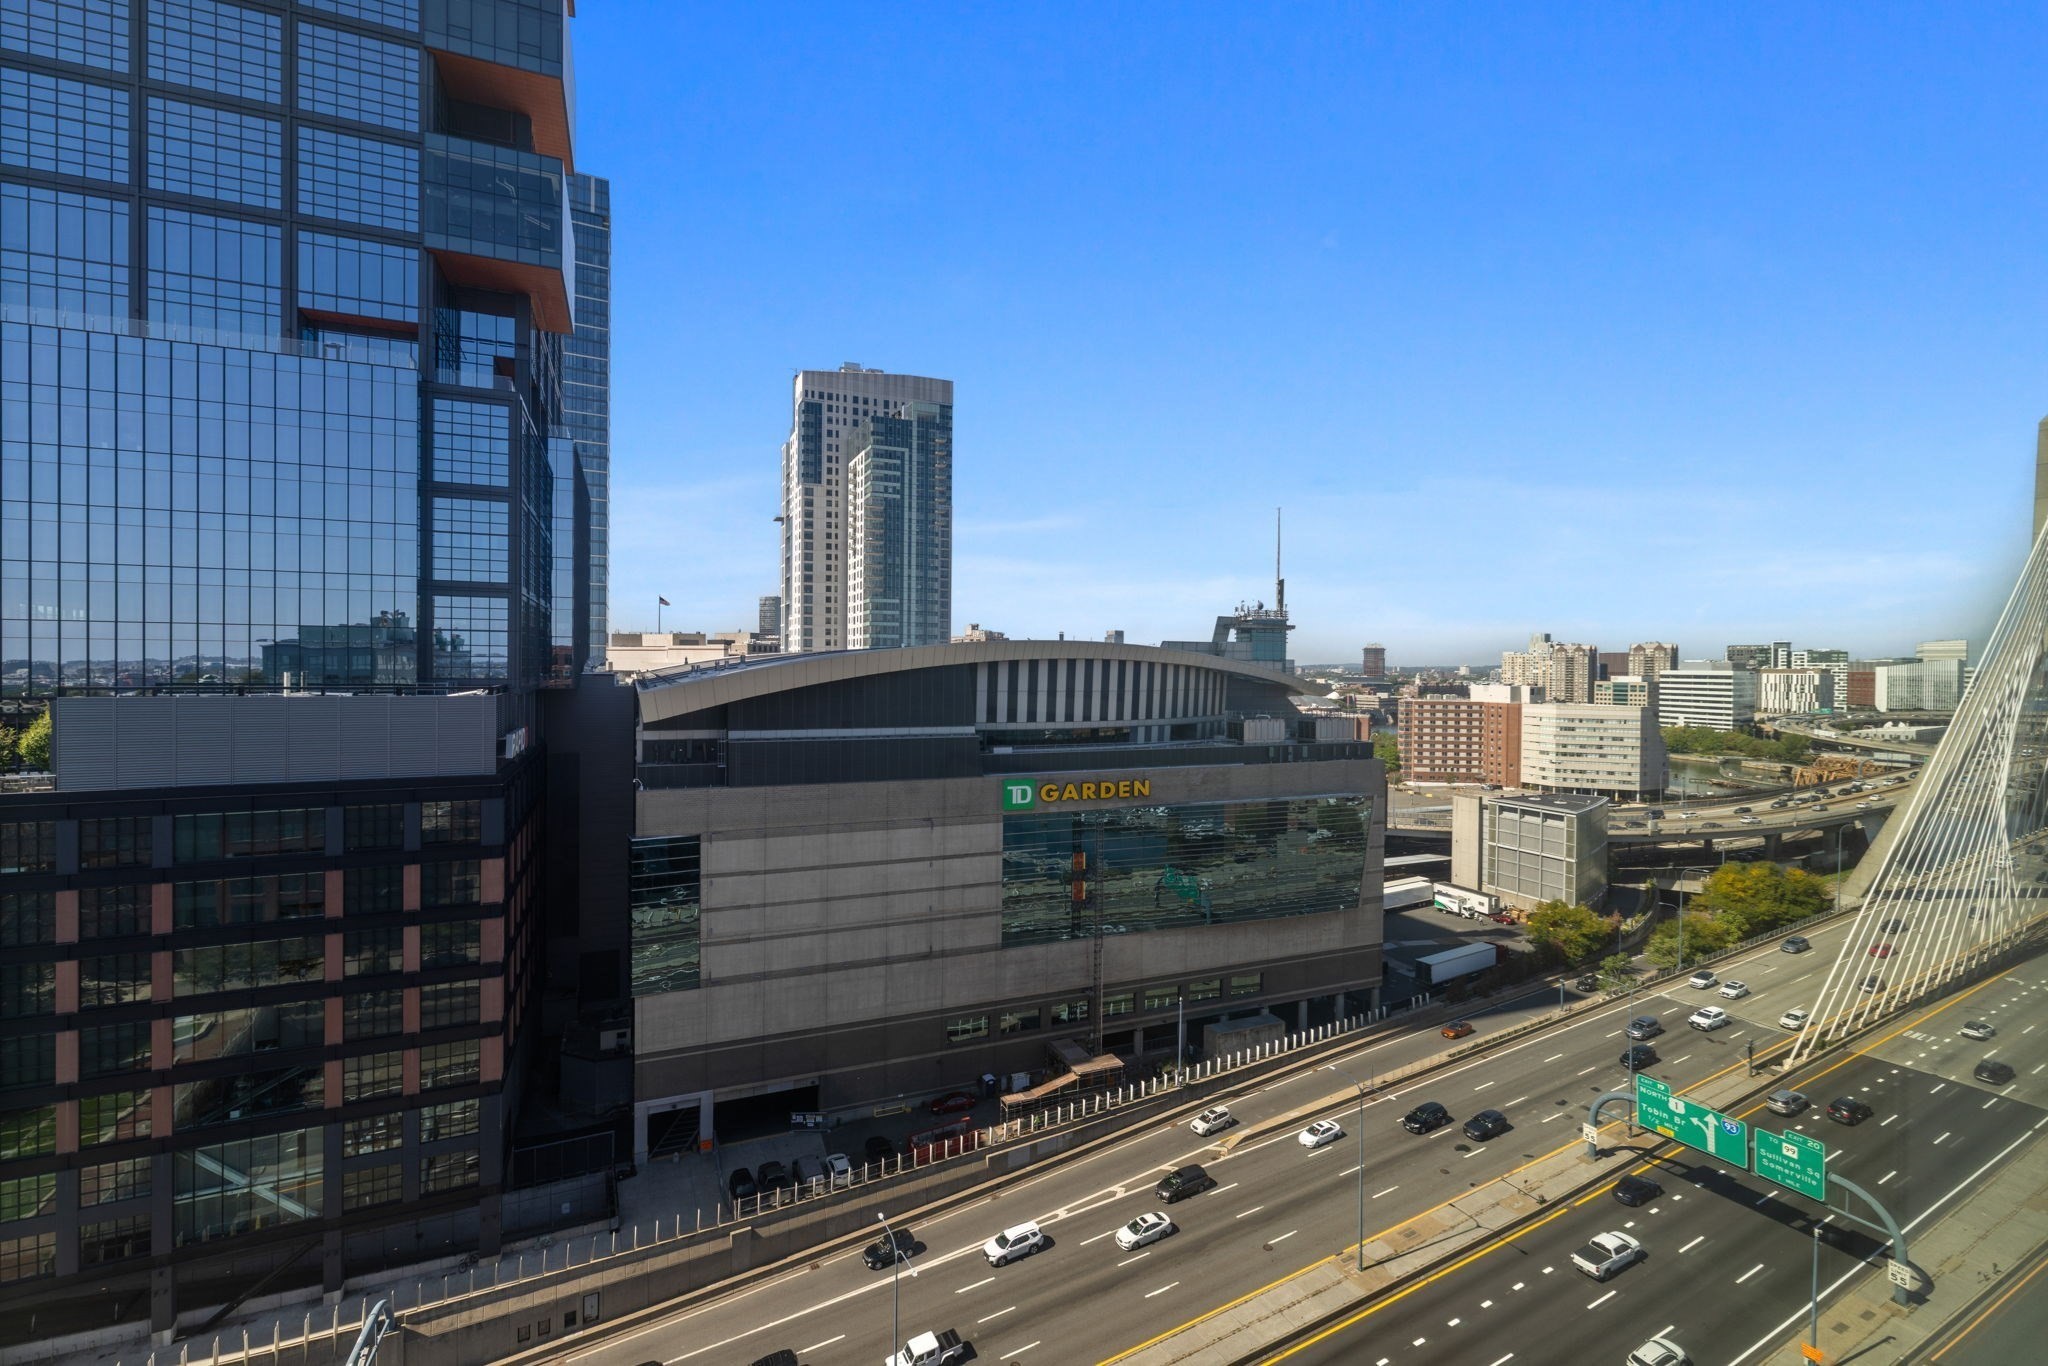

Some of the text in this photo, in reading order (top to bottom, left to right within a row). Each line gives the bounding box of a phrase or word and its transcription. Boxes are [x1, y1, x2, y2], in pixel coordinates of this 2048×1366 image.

[1007, 779, 1150, 804] TD GARDEN
[1902, 1030, 1937, 1043] ONLY
[1641, 1077, 1665, 1091] EXIT 19
[1640, 1085, 1668, 1102] NORTH
[1641, 1102, 1687, 1126] Tobin Br
[1663, 1121, 1679, 1132] MILE
[1724, 1122, 1737, 1134] 93
[1584, 1132, 1596, 1143] 55
[1768, 1136, 1779, 1144] TO
[1788, 1133, 1820, 1150] EXIT 20
[1784, 1145, 1796, 1155] 99
[1760, 1148, 1820, 1180] Sullivan Sq
[1762, 1158, 1817, 1187] Somerville
[1890, 1272, 1907, 1286] 55
